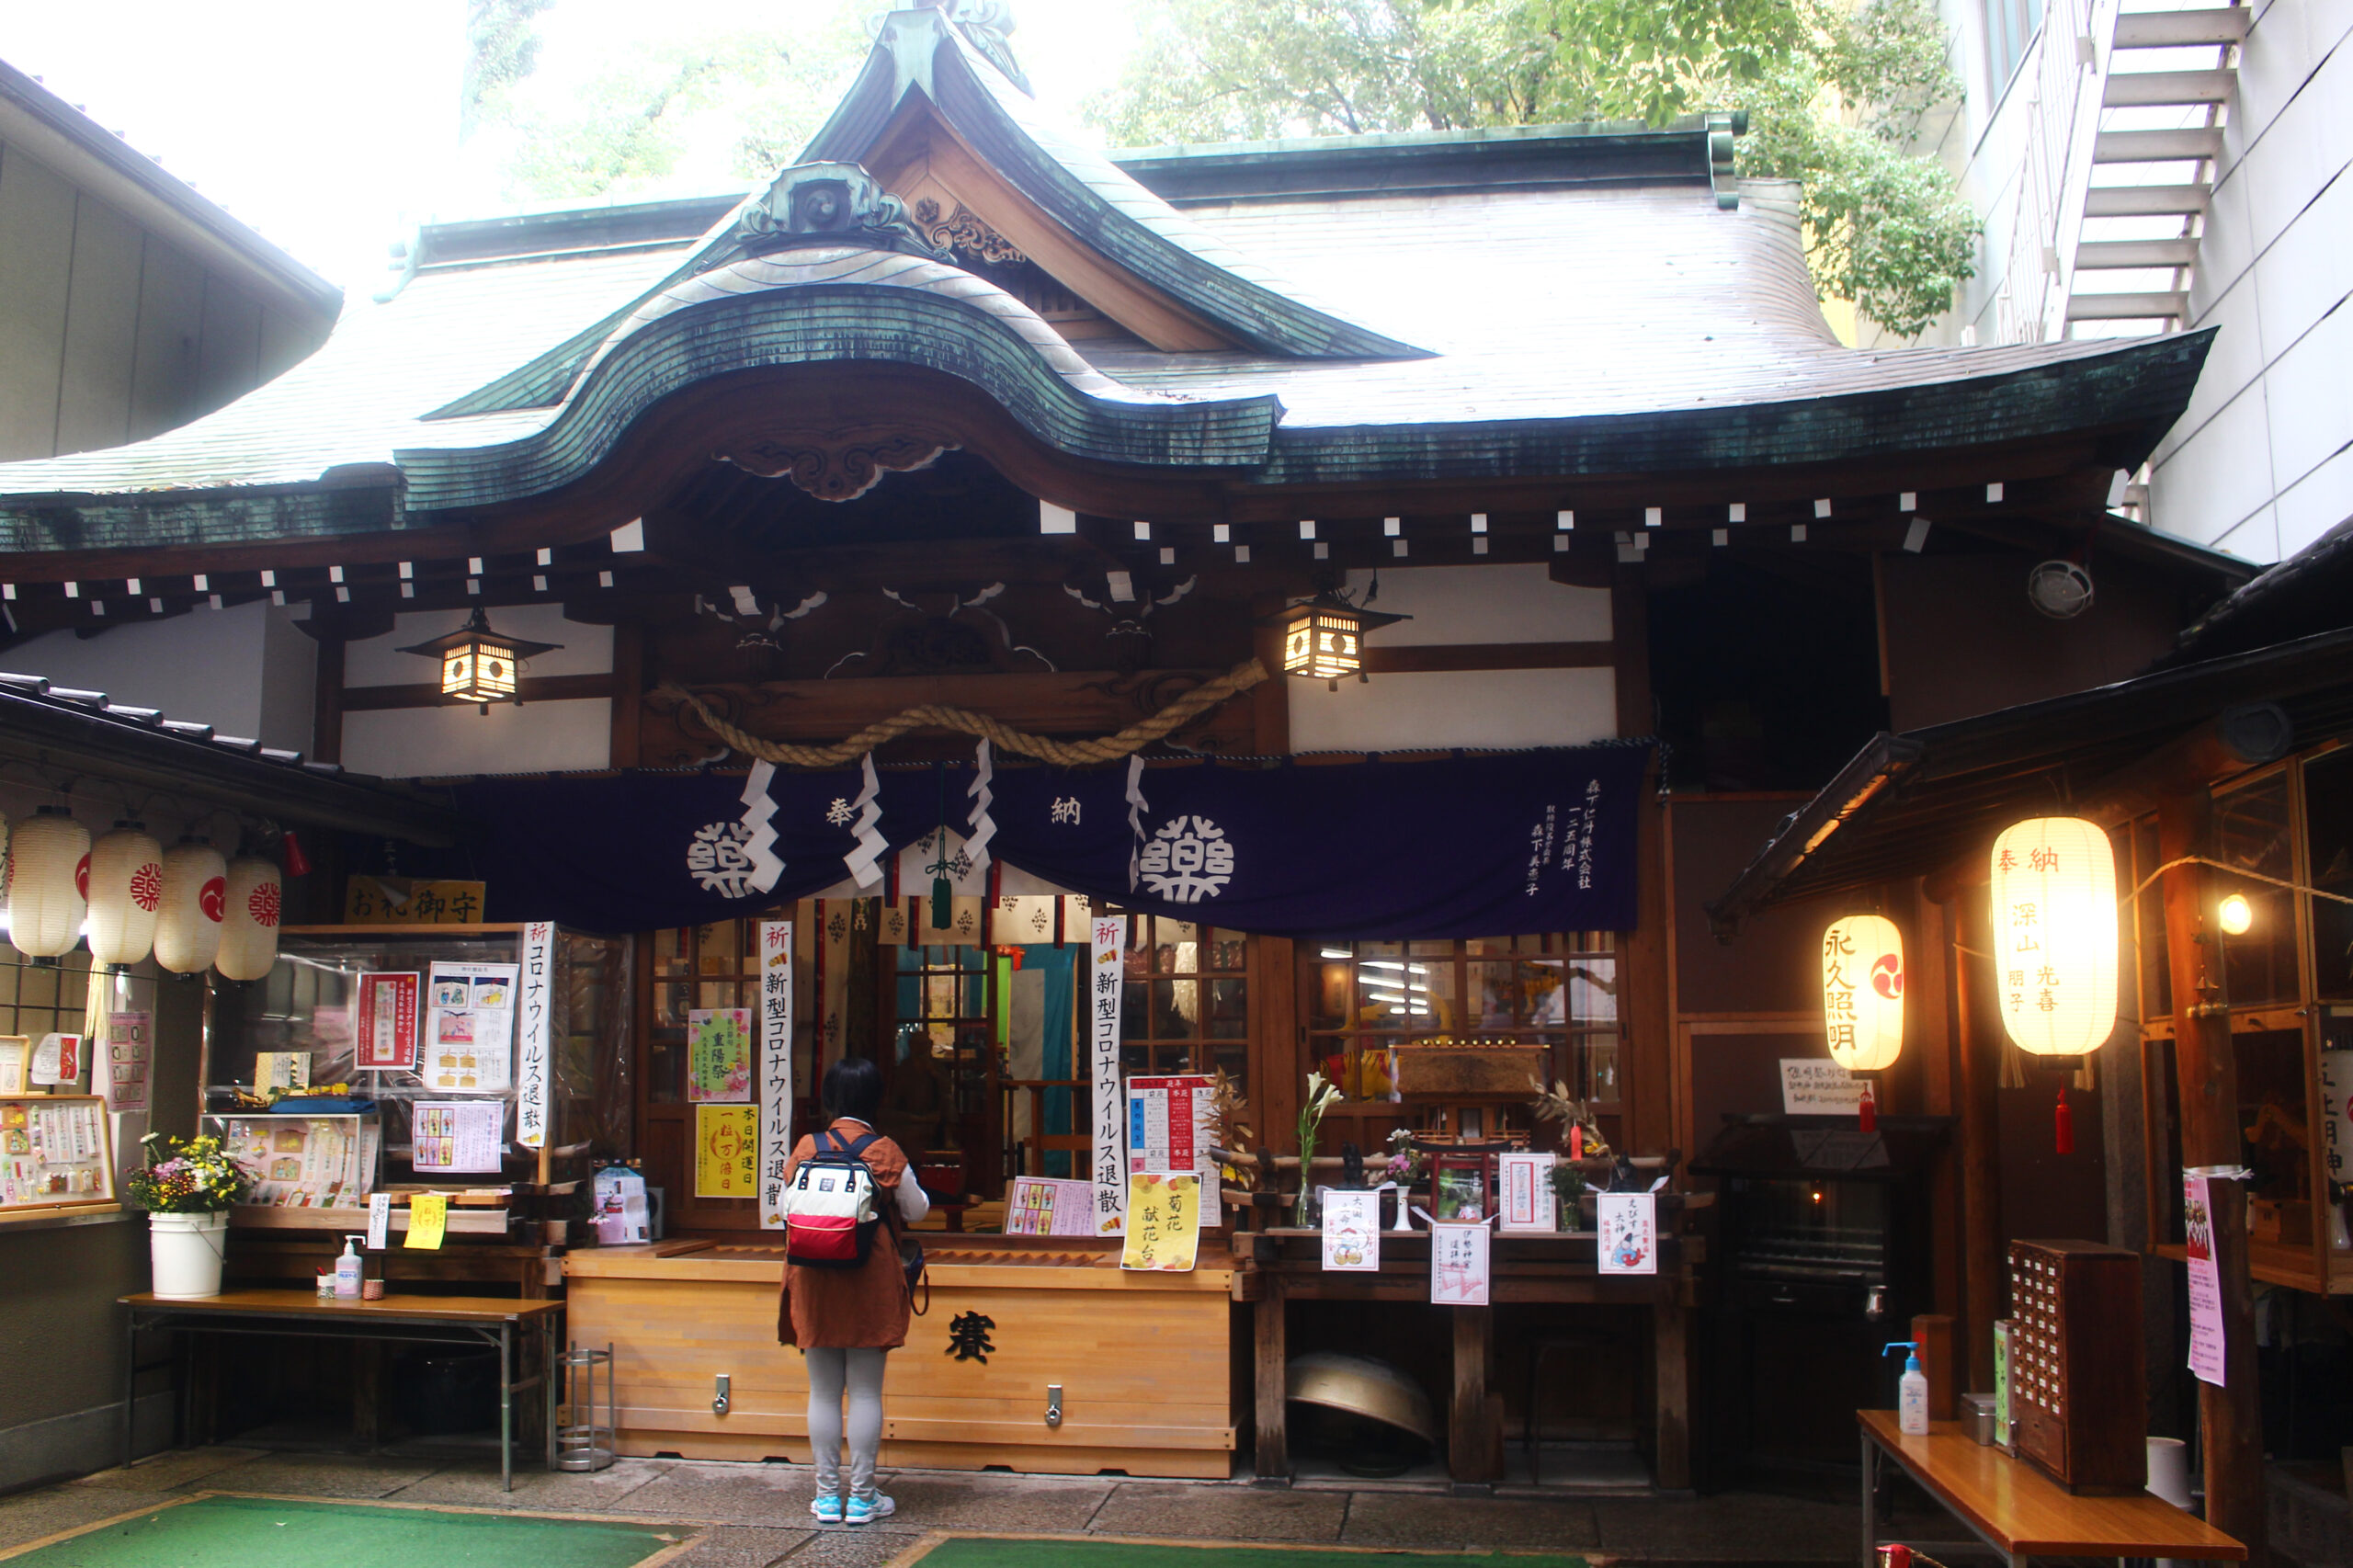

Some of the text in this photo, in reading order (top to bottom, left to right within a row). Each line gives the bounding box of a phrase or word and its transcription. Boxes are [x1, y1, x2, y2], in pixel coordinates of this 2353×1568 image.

[826, 796, 1082, 826] 奉 納
[1562, 807, 1581, 871] 一二五周年
[1578, 778, 1601, 890] 森下仁丹株式会社
[1824, 929, 1859, 1051] 永久照明
[711, 1031, 732, 1081] 重陽祭
[720, 1112, 734, 1190] 一粒万倍日
[742, 1108, 756, 1185] 本日開運日
[1141, 1206, 1160, 1261] 献花台
[1166, 1195, 1184, 1233] 菊花
